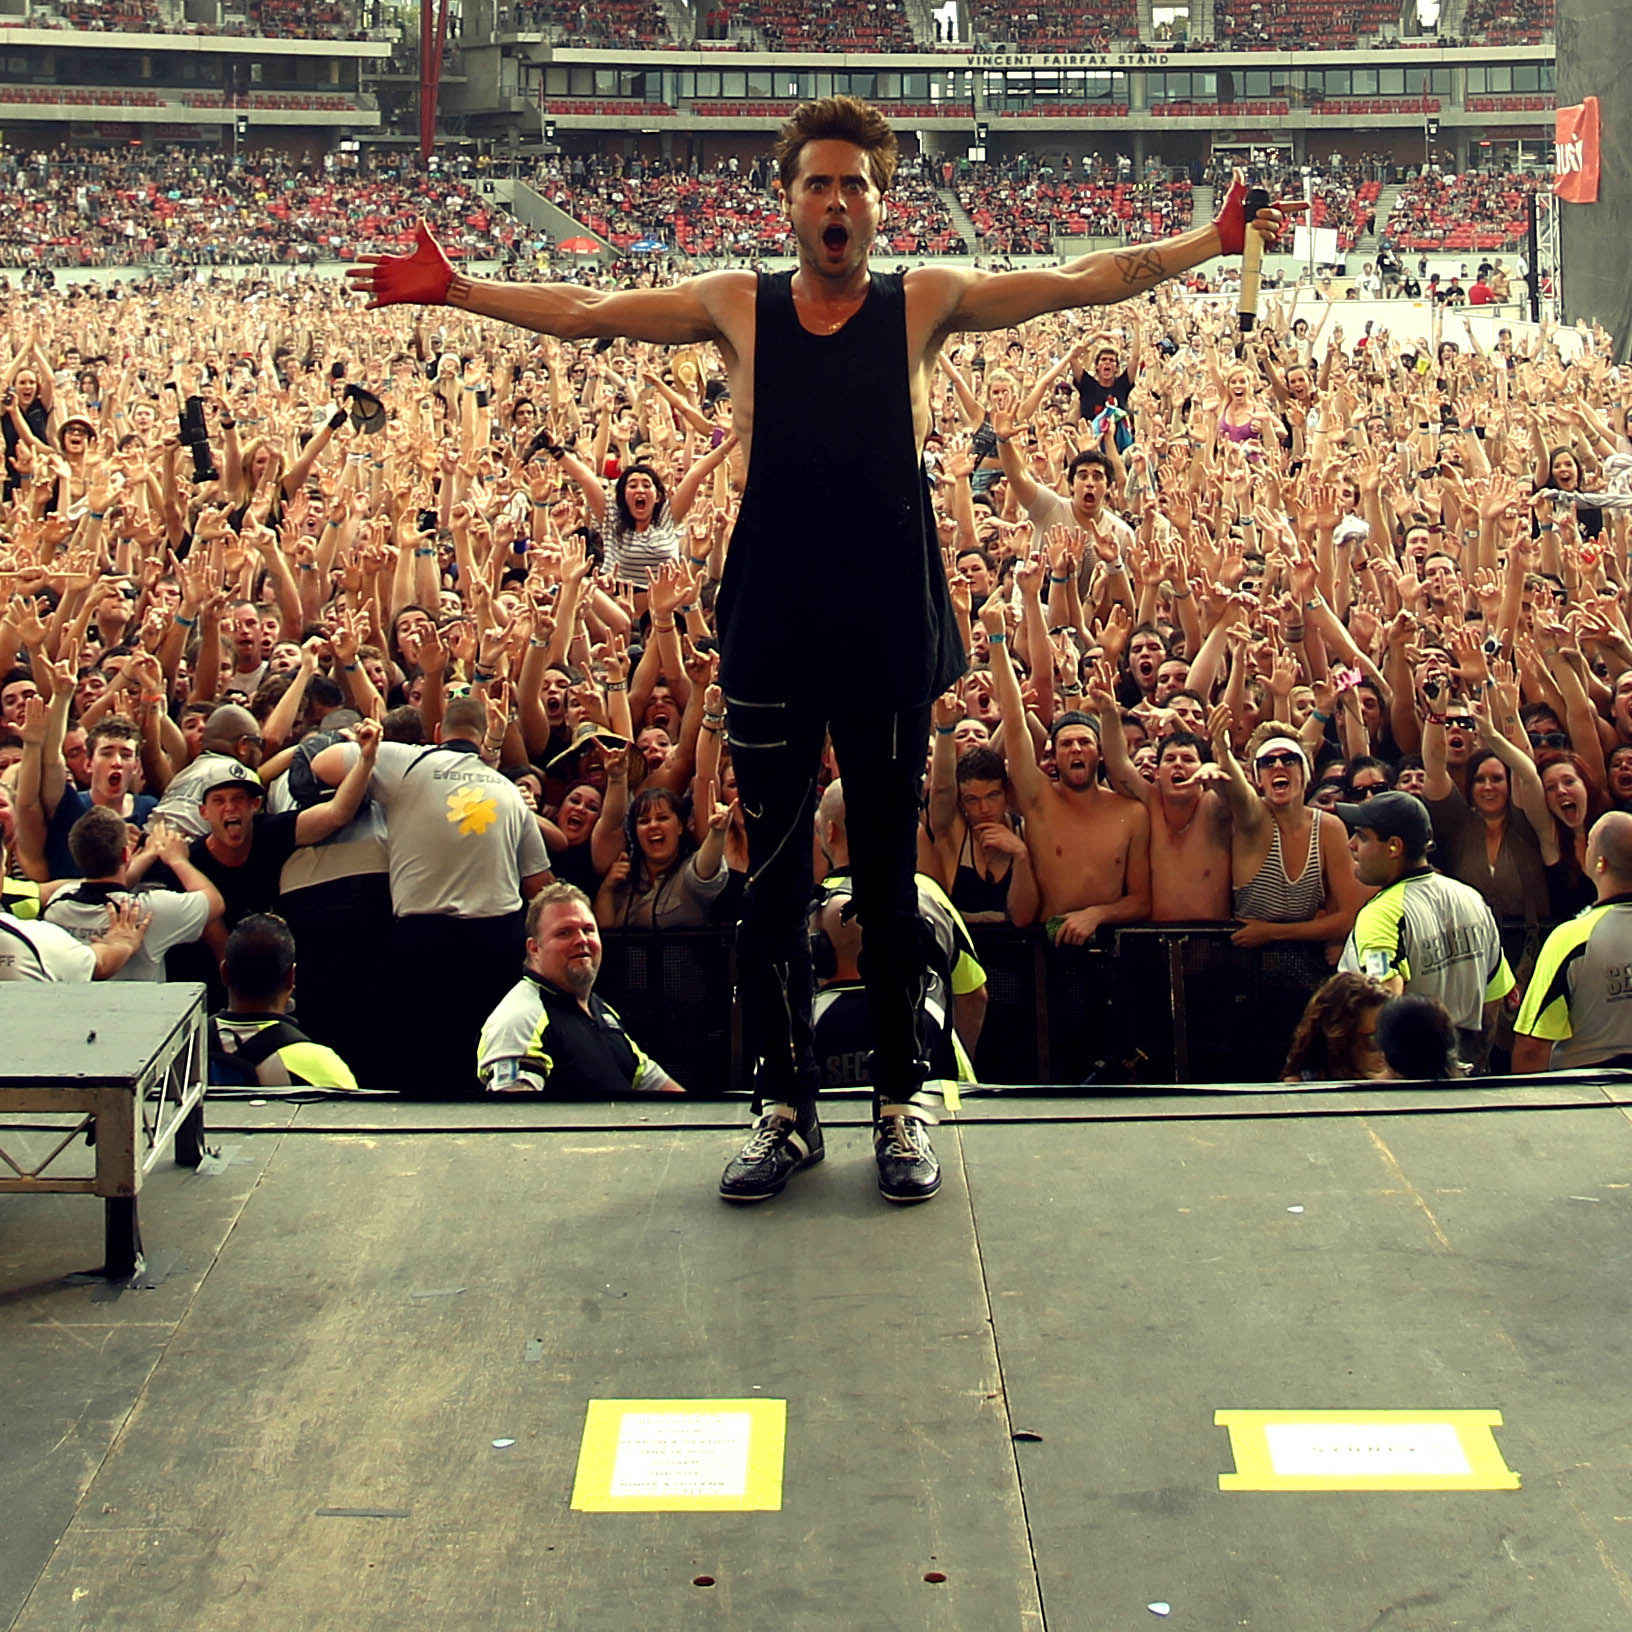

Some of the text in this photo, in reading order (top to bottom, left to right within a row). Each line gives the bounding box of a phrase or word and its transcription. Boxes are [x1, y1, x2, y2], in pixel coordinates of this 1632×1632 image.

[967, 54, 1169, 65] VINCENT FAIRFAX STAND
[432, 770, 473, 781] EVENT
[1421, 924, 1487, 968] SECURITY
